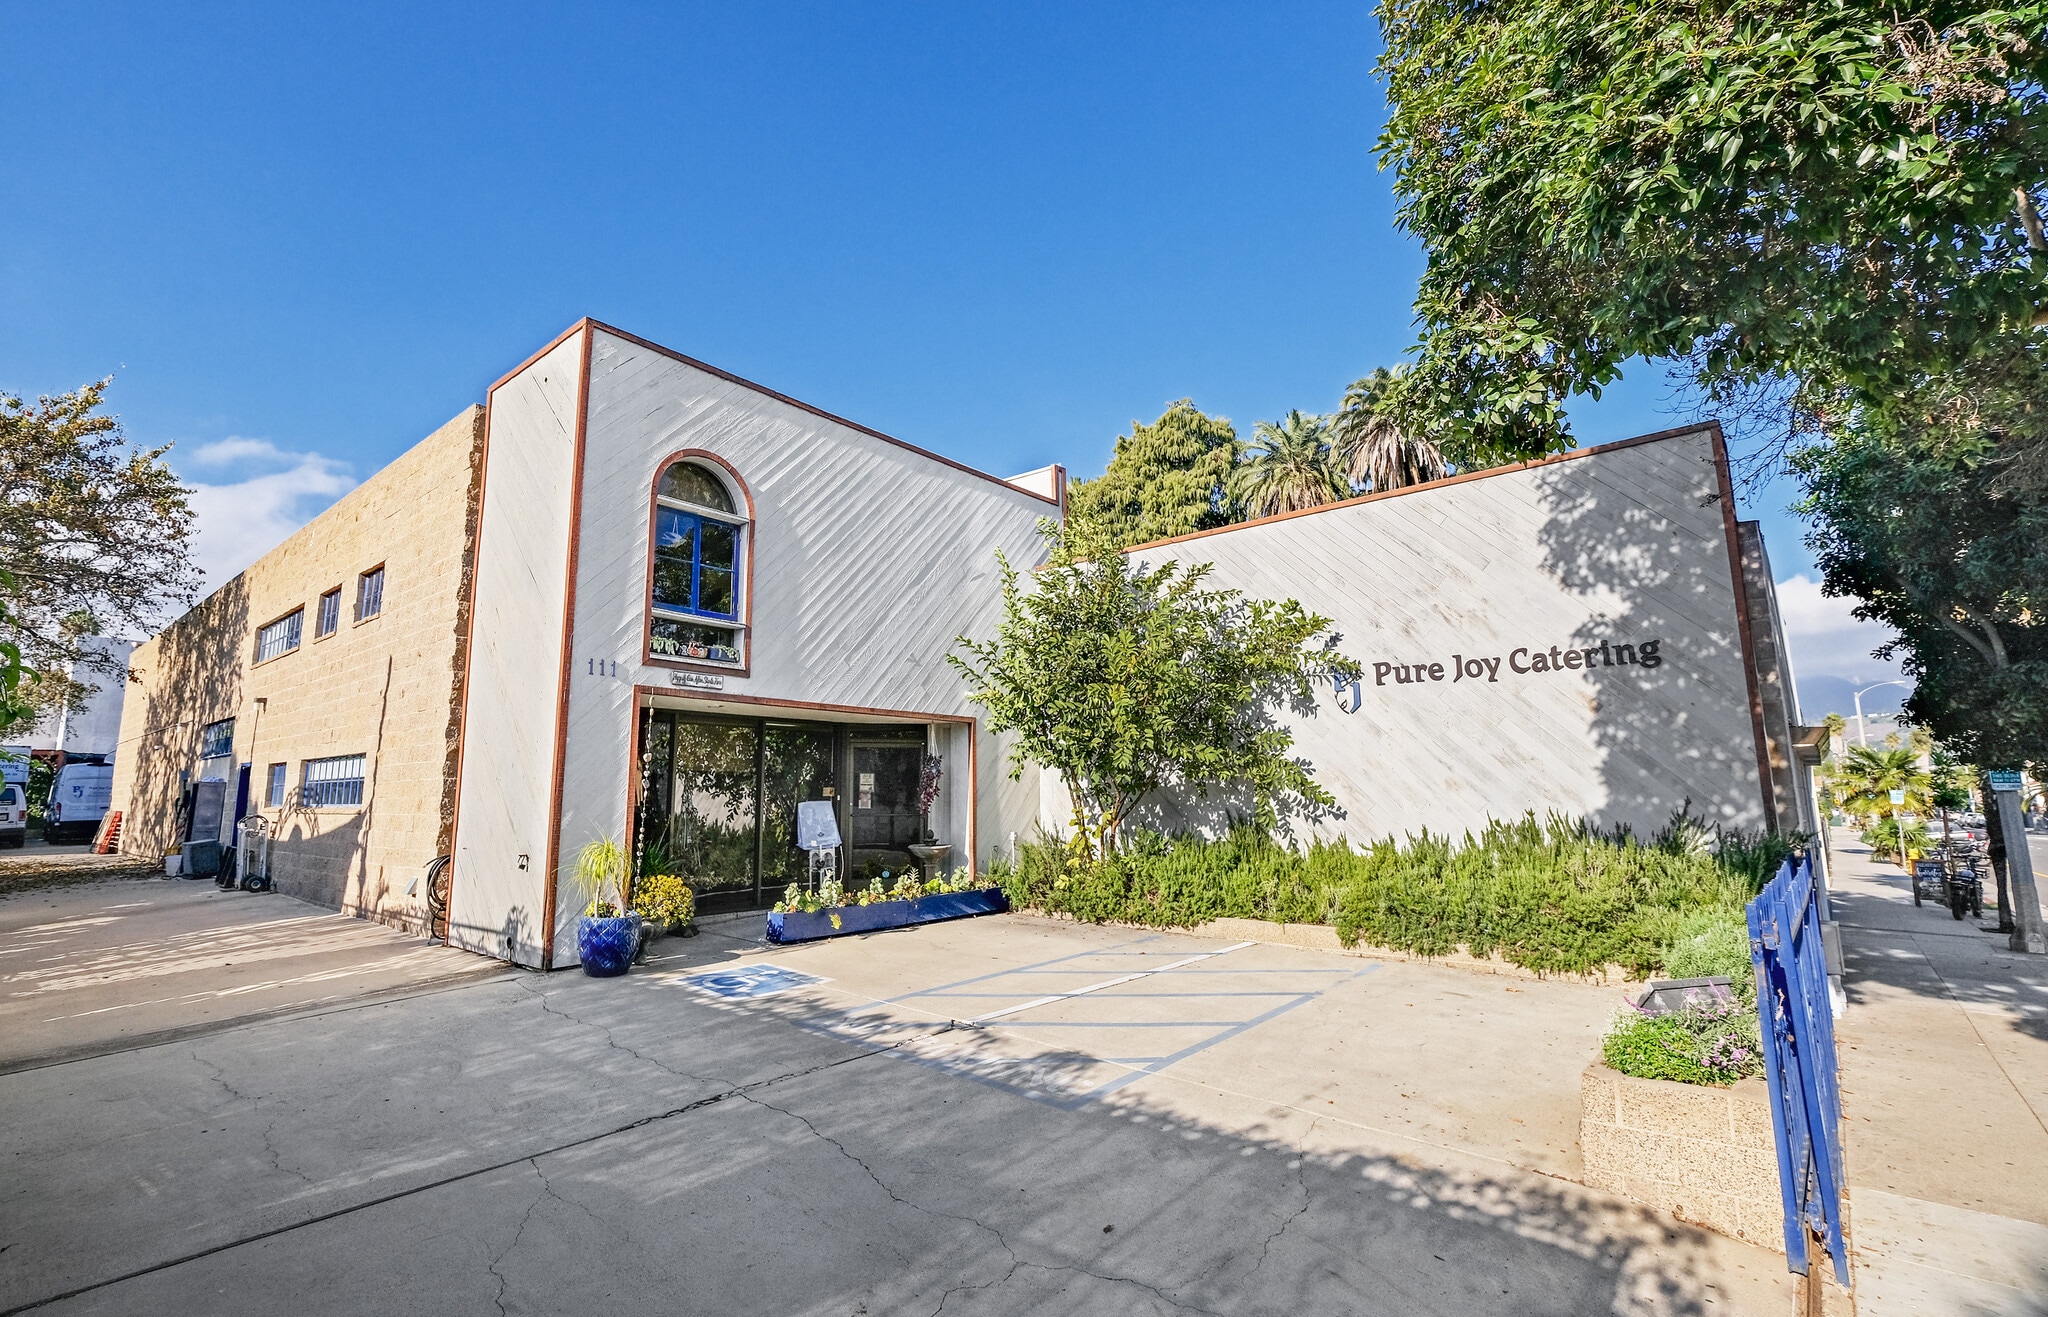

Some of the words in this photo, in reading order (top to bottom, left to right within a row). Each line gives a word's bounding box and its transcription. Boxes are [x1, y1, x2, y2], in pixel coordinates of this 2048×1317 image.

[588, 657, 616, 677] 111
[1372, 661, 1445, 686] Pure
[1451, 654, 1501, 683] Joy
[1508, 639, 1662, 674] Catering
